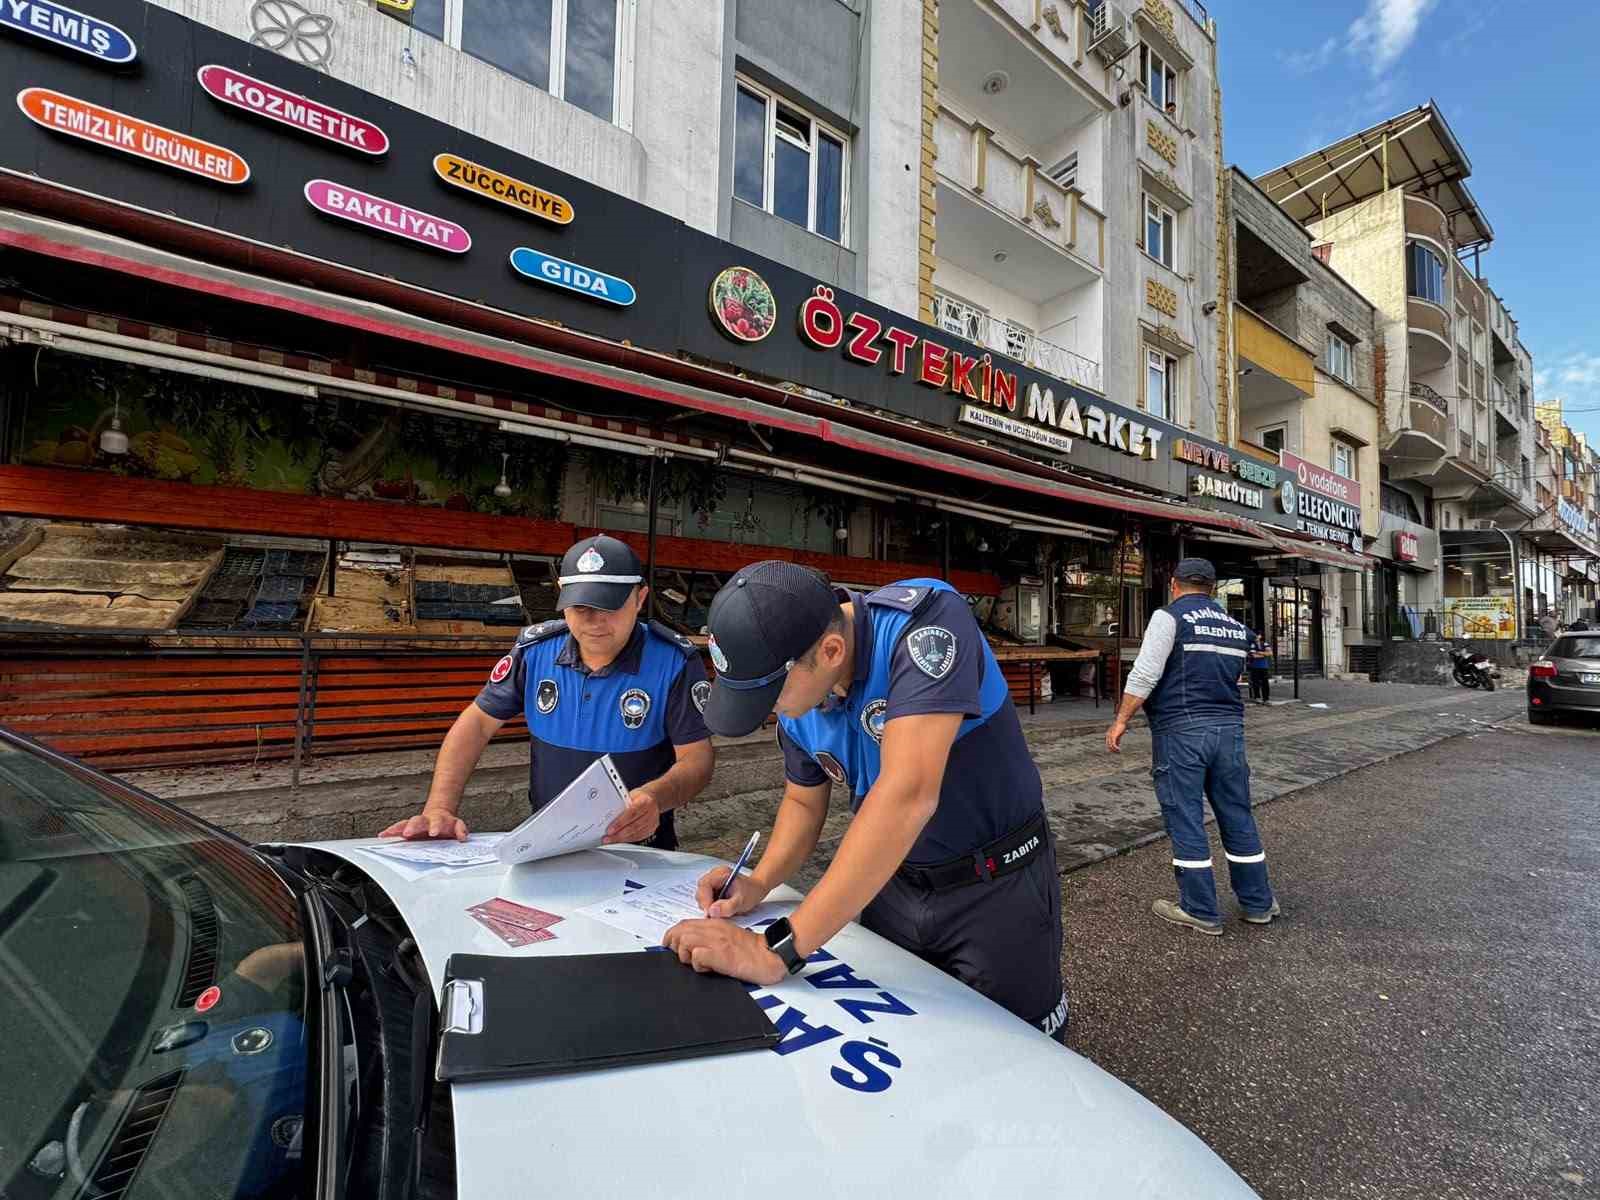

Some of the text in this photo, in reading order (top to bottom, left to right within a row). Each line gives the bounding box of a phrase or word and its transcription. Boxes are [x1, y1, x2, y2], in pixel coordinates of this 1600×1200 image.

[0, 0, 111, 55] YEMİŞ
[41, 100, 233, 178] TEMİZLİK ÜRÜNLERİ
[224, 78, 367, 146] KOZMETİK
[327, 189, 454, 243] BAKLİYAT
[447, 161, 563, 218] ZÜCCACİYE
[541, 260, 608, 296] GIDA
[803, 284, 1163, 460] ÖZTEKİN MARKET
[1309, 471, 1348, 499] vodafone
[1003, 835, 1040, 864] ZABITA
